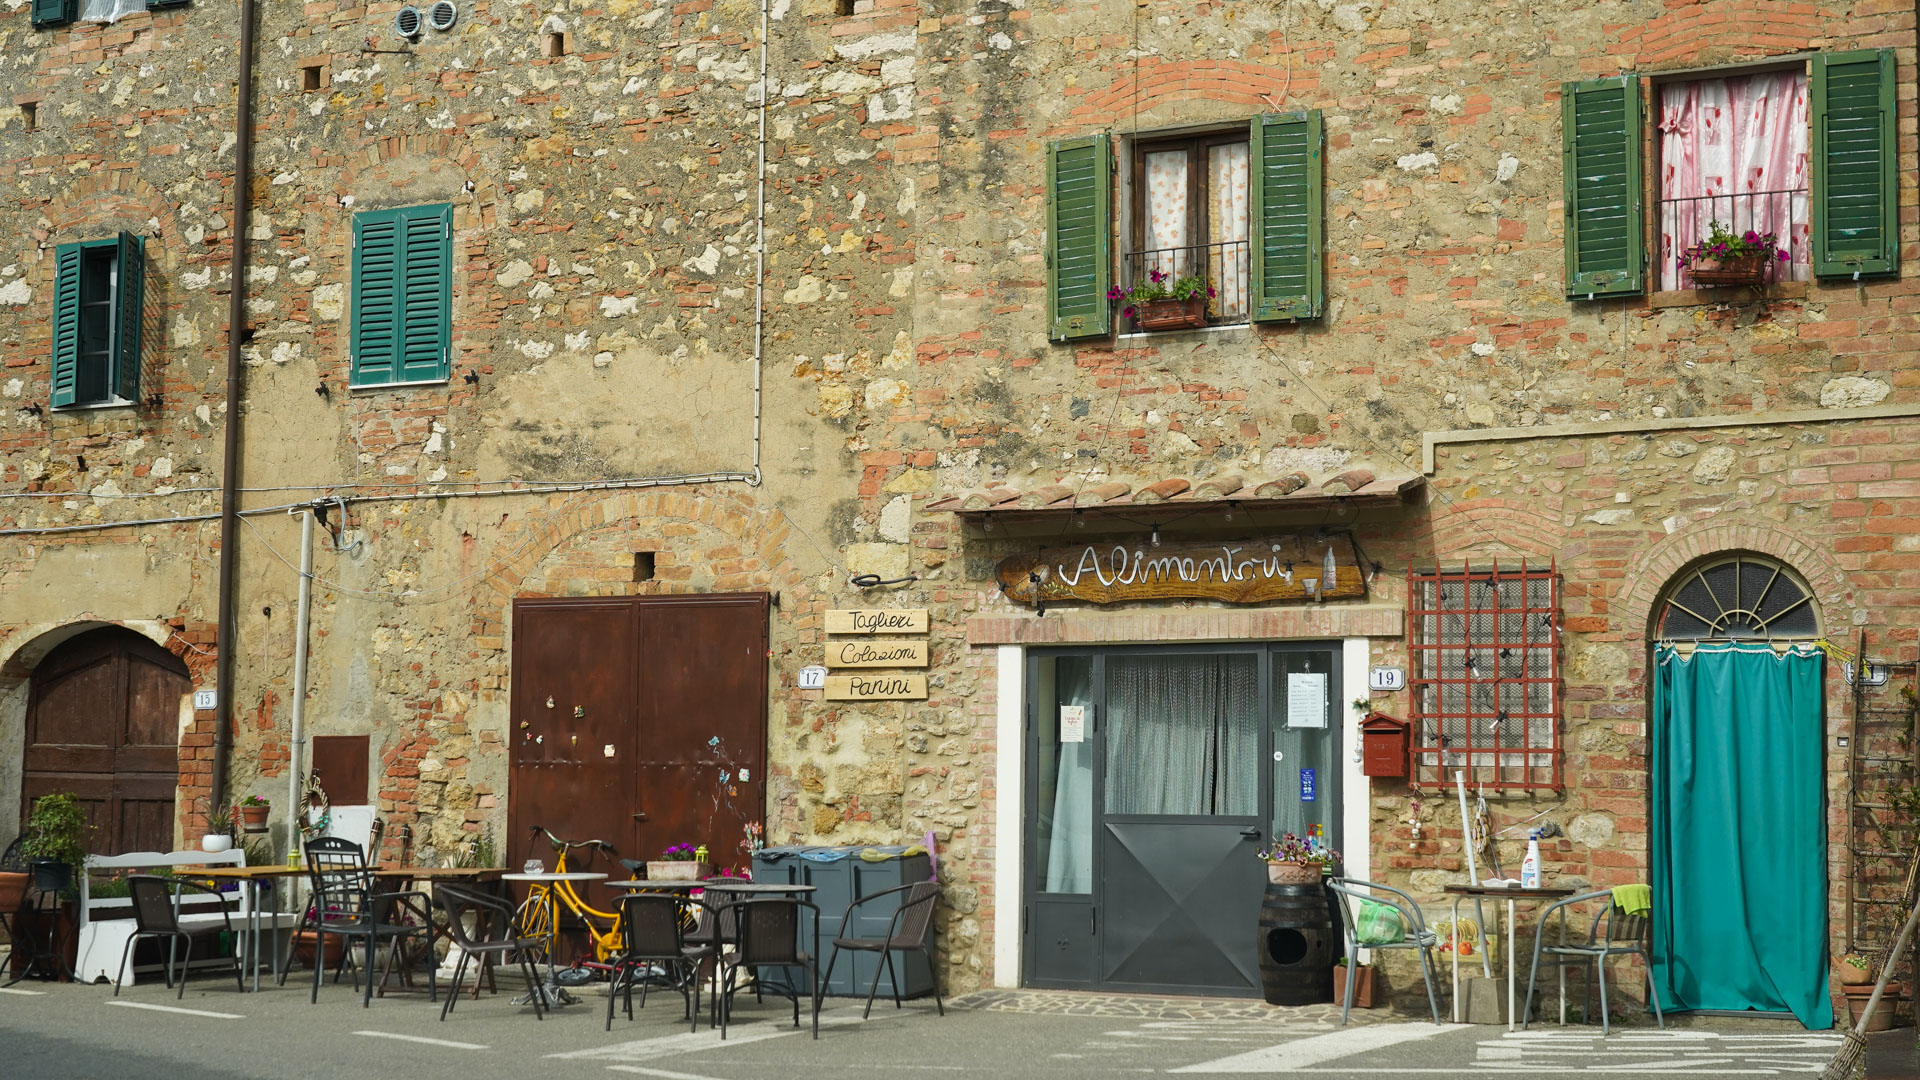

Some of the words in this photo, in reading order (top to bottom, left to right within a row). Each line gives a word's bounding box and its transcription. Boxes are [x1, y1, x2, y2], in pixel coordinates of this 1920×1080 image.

[1058, 544, 1288, 587] Alimentari
[848, 611, 914, 633] Taglieri
[840, 643, 917, 664] Colazioni
[806, 672, 819, 685] 17
[849, 676, 911, 696] Panini
[1378, 671, 1395, 686] 19
[200, 694, 211, 705] 15
